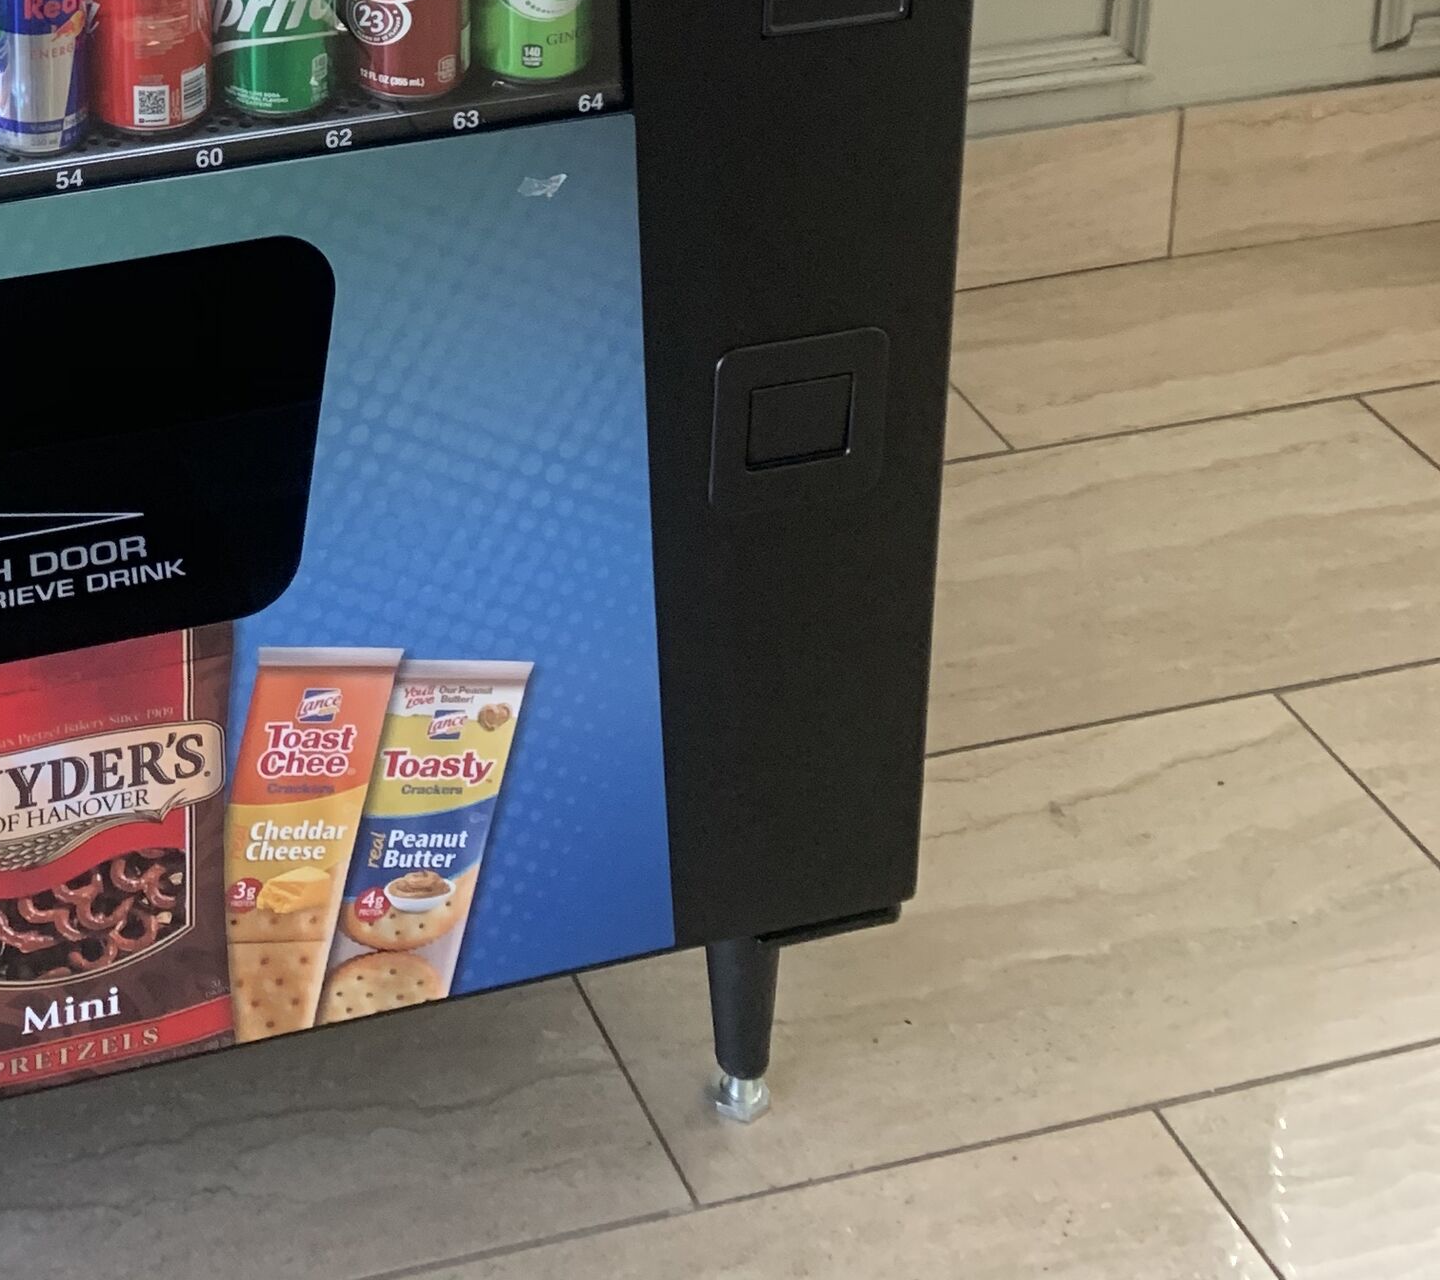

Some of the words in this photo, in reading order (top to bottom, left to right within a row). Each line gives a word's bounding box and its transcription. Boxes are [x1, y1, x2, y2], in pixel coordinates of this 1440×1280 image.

[358, 4, 385, 33] 23
[577, 92, 604, 112] 64
[452, 109, 480, 130] 63
[325, 127, 353, 149] 62
[196, 147, 224, 169] 60
[55, 168, 84, 190] 54
[29, 536, 148, 579] DOOR
[86, 557, 186, 595] DRINK
[267, 722, 356, 751] Toast
[259, 750, 348, 777] Chee
[383, 750, 494, 784] Toasty
[26, 789, 150, 829] HANOVER
[250, 820, 348, 841] Cheddar
[245, 841, 327, 862] Cheese
[367, 830, 386, 868] real
[388, 828, 469, 849] Peanut
[382, 849, 457, 869] Butter
[21, 986, 122, 1035] Mini
